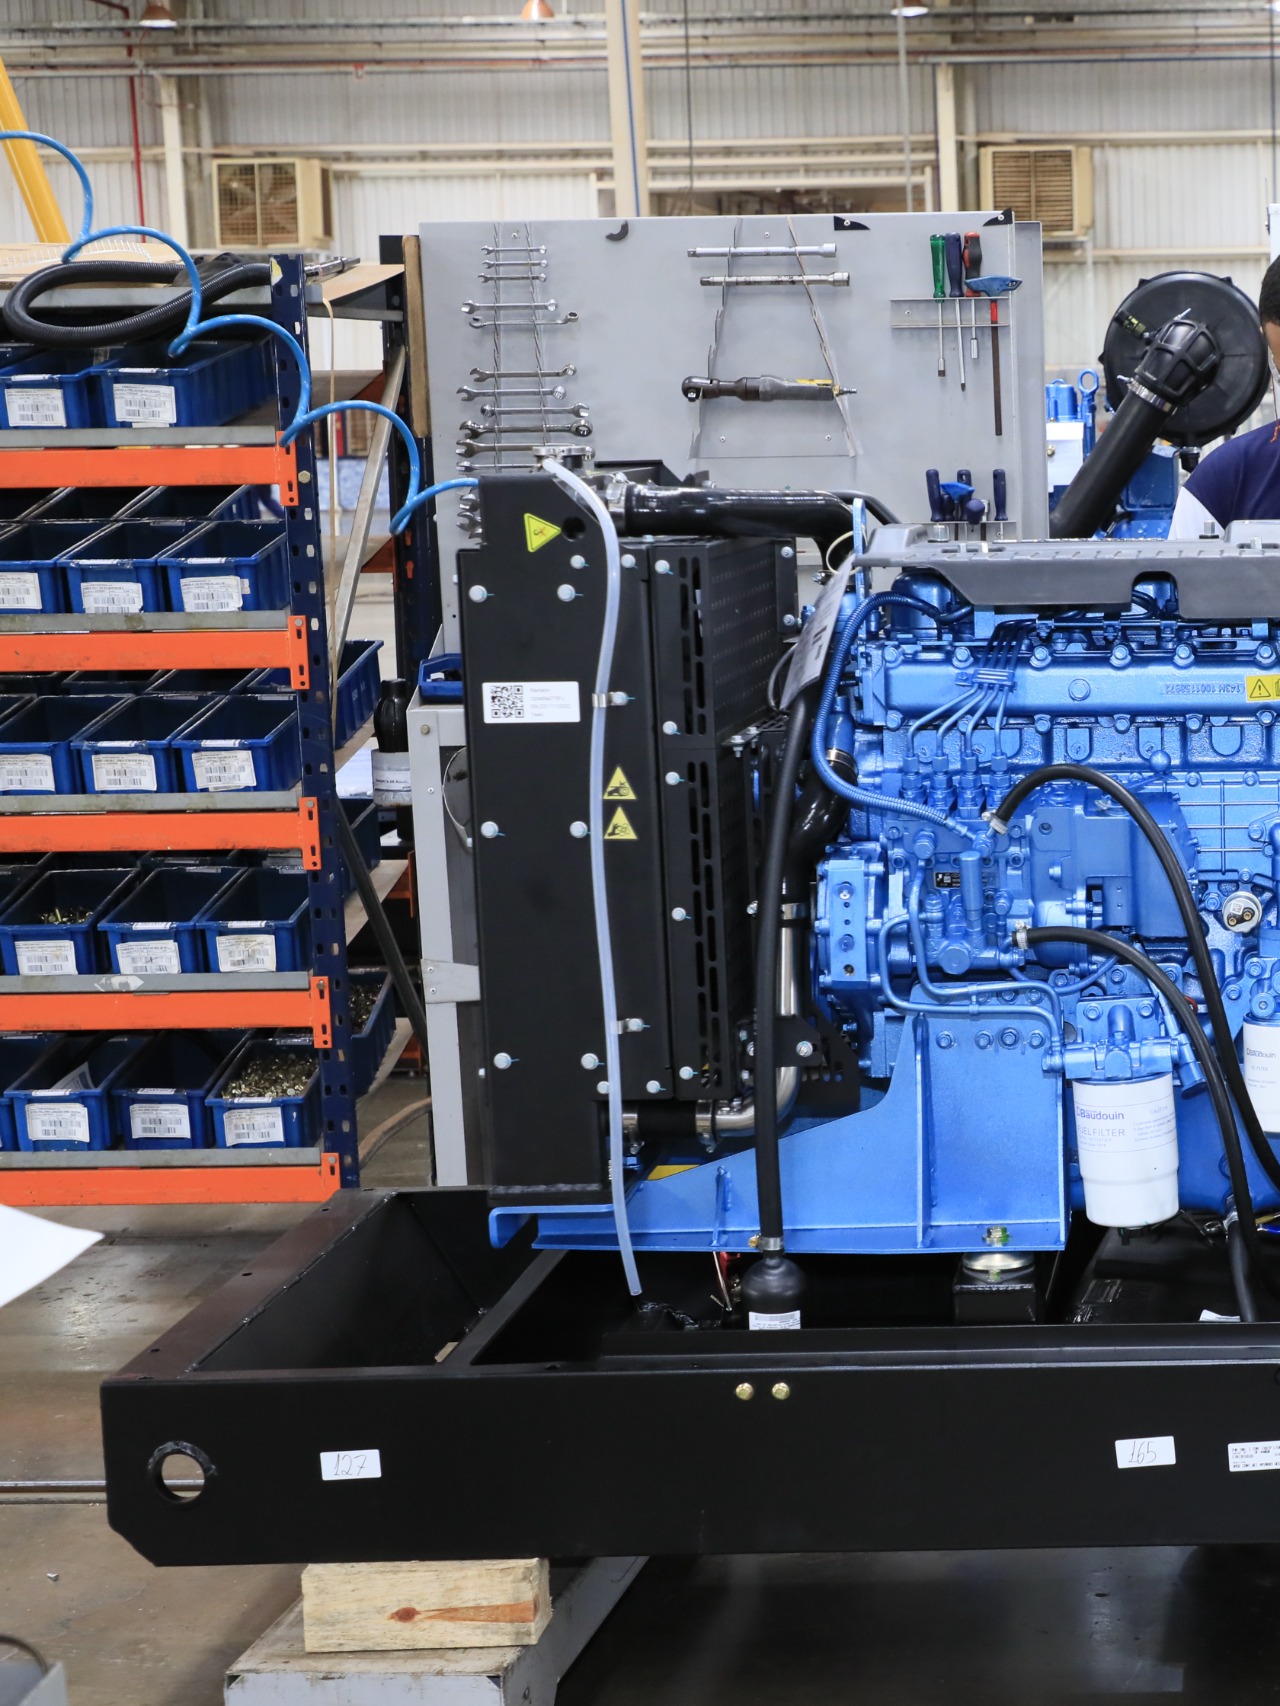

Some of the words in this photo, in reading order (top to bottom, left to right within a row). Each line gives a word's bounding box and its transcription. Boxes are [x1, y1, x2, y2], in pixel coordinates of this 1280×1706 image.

[1080, 1108, 1125, 1120] Baudouin
[1128, 1440, 1157, 1464] 165
[334, 1453, 366, 1476] 127
